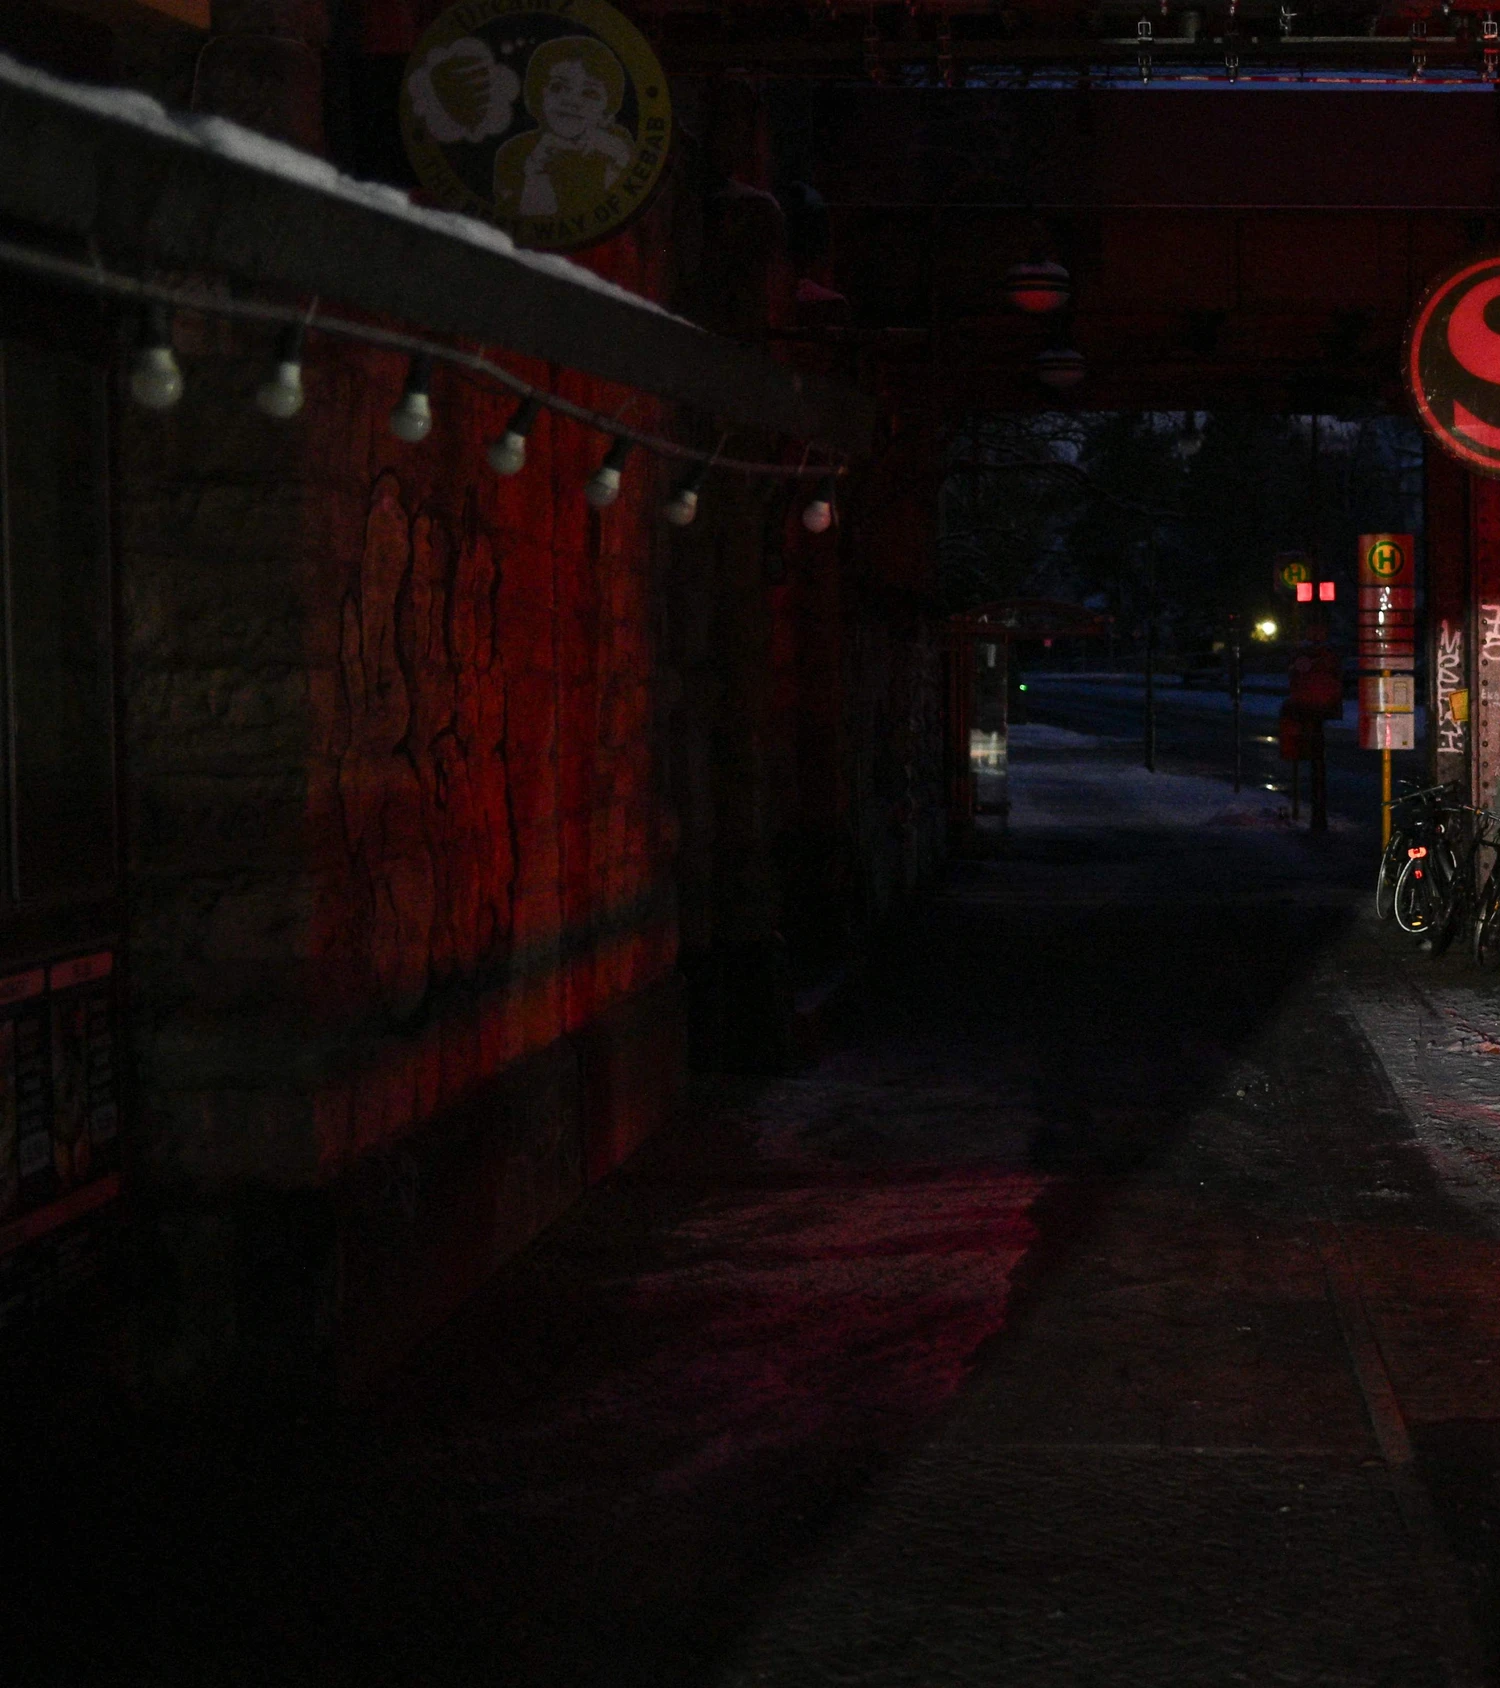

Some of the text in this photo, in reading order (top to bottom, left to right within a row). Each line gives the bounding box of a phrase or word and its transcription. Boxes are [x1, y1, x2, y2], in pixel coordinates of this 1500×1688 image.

[421, 153, 462, 204] THE
[533, 213, 586, 240] WAY
[594, 194, 620, 223] OF
[622, 117, 665, 198] KEBAB
[1378, 548, 1396, 570] H
[1289, 566, 1302, 582] H
